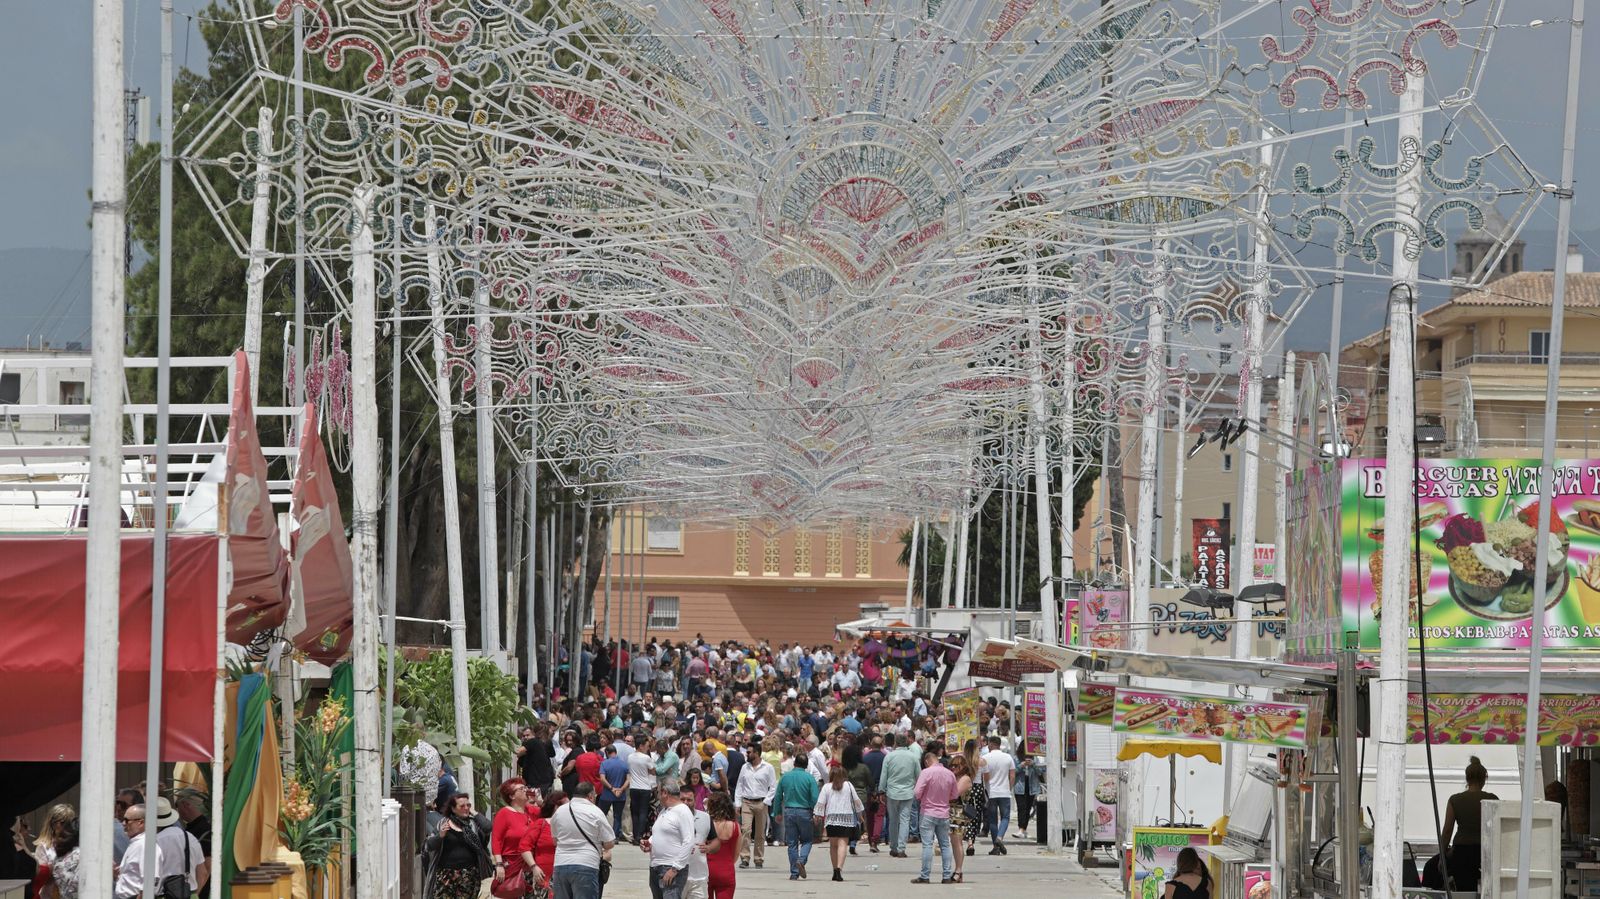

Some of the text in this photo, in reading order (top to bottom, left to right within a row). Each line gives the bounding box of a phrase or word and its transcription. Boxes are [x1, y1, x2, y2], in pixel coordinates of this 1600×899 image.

[1215, 549, 1226, 589] ASADAS
[1435, 698, 1482, 706] LOMOS
[1486, 698, 1524, 707] KEBAB
